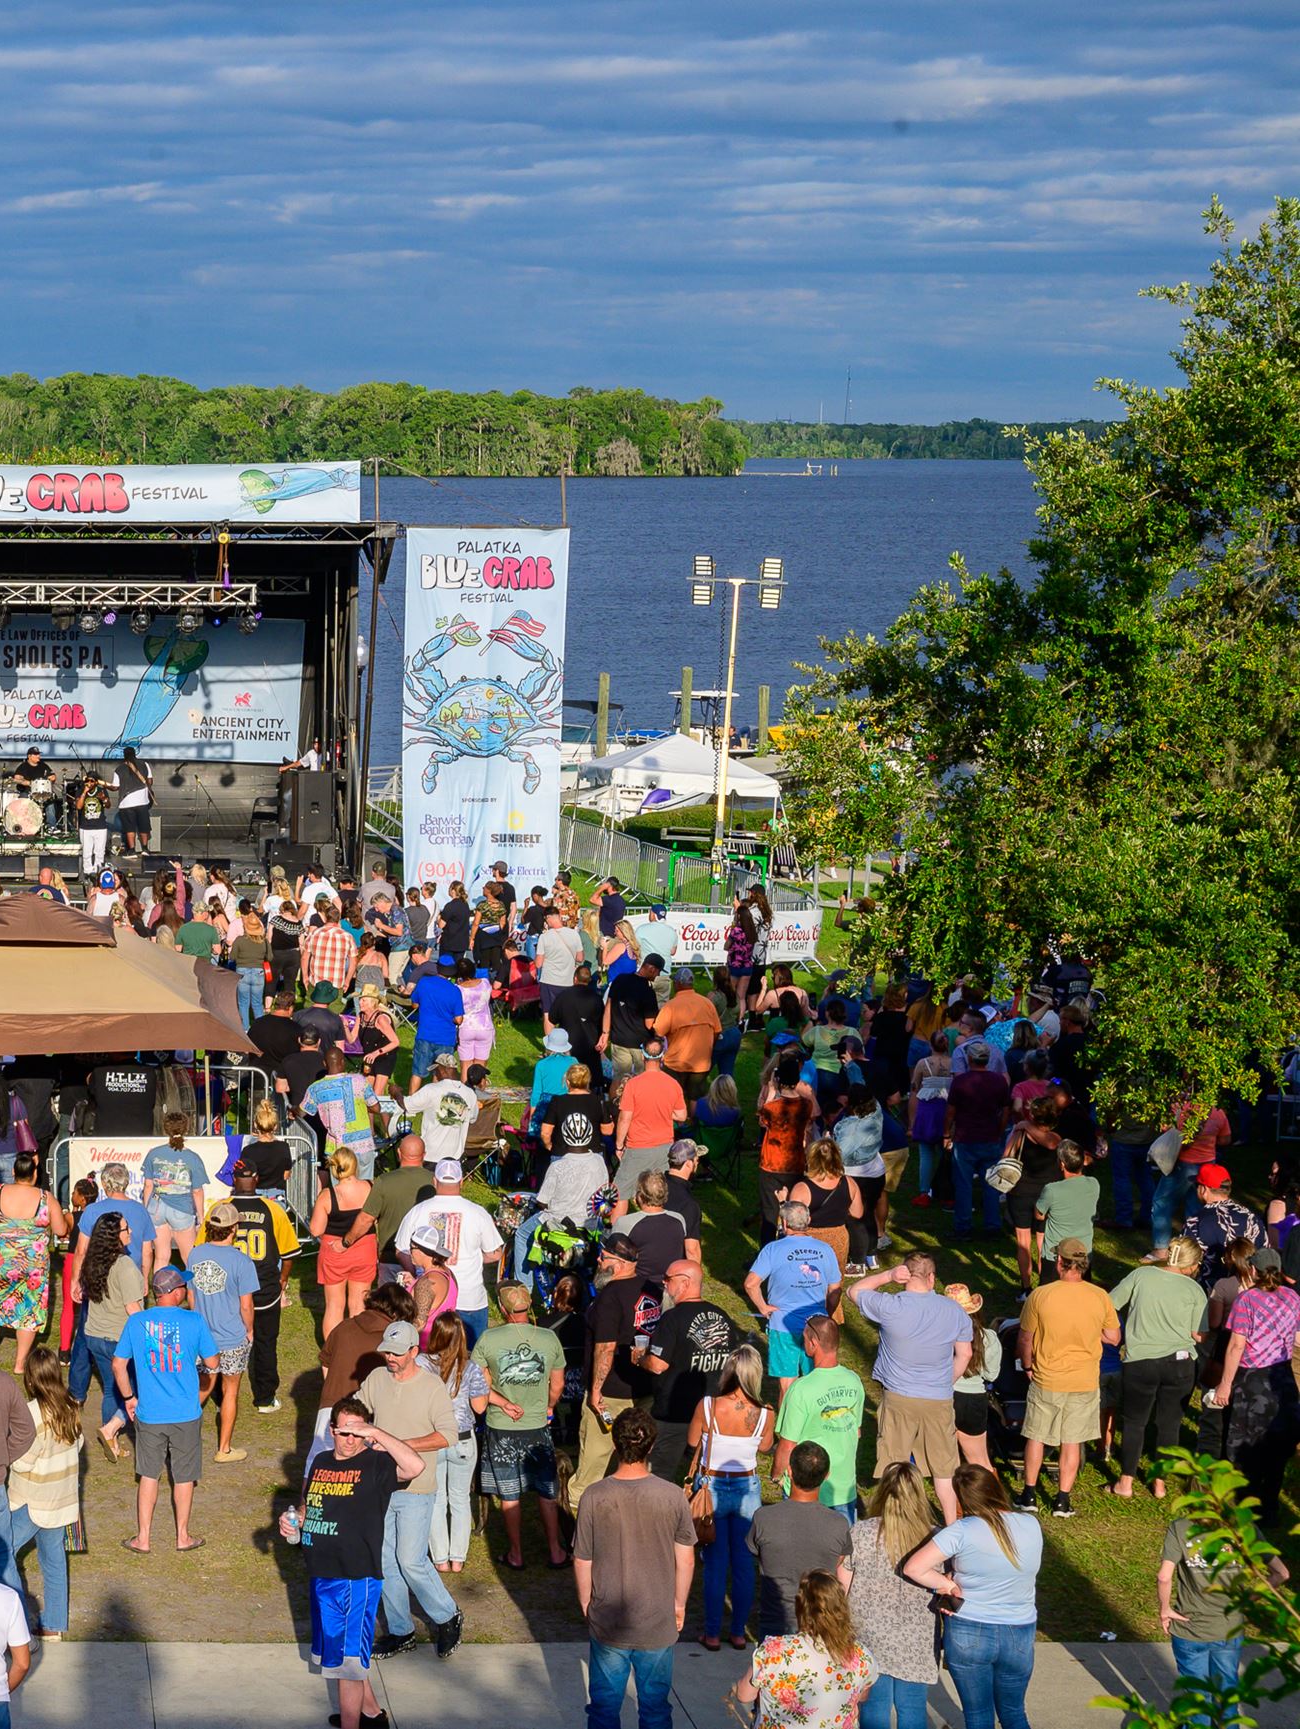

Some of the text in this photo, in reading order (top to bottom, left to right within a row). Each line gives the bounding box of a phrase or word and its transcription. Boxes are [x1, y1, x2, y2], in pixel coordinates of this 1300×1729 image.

[26, 472, 130, 513] CRAB
[131, 486, 208, 500] FESTIVAL
[457, 541, 521, 554] PALATKA
[421, 554, 555, 590] BLUE CRAB
[460, 593, 514, 603] FESTIVAL
[3, 645, 73, 669] SHOLES
[79, 646, 109, 669] P.A.
[3, 690, 62, 700] PALATKA
[28, 704, 87, 730] CRAB
[200, 716, 284, 729] ANCIENT CITY
[6, 734, 57, 743] FESTIVAL
[192, 728, 291, 741] ENTERTAINMENT
[425, 814, 466, 826] Barwick
[419, 824, 461, 837] Banking
[428, 834, 476, 848] Company
[491, 833, 541, 843] SUNBELT
[517, 865, 548, 876] Electric
[682, 924, 720, 941] Coors
[785, 926, 810, 941] Coors
[685, 941, 716, 951] LIGHT
[787, 941, 808, 950] LIGHT
[90, 1147, 142, 1162] Welcome
[234, 1229, 266, 1260] 50
[688, 1312, 706, 1334] NEVER
[691, 1353, 729, 1373] FIGHT
[817, 1389, 858, 1406] GUY HARVEY
[306, 1493, 323, 1507] PIC.
[303, 1519, 338, 1536] UARY.
